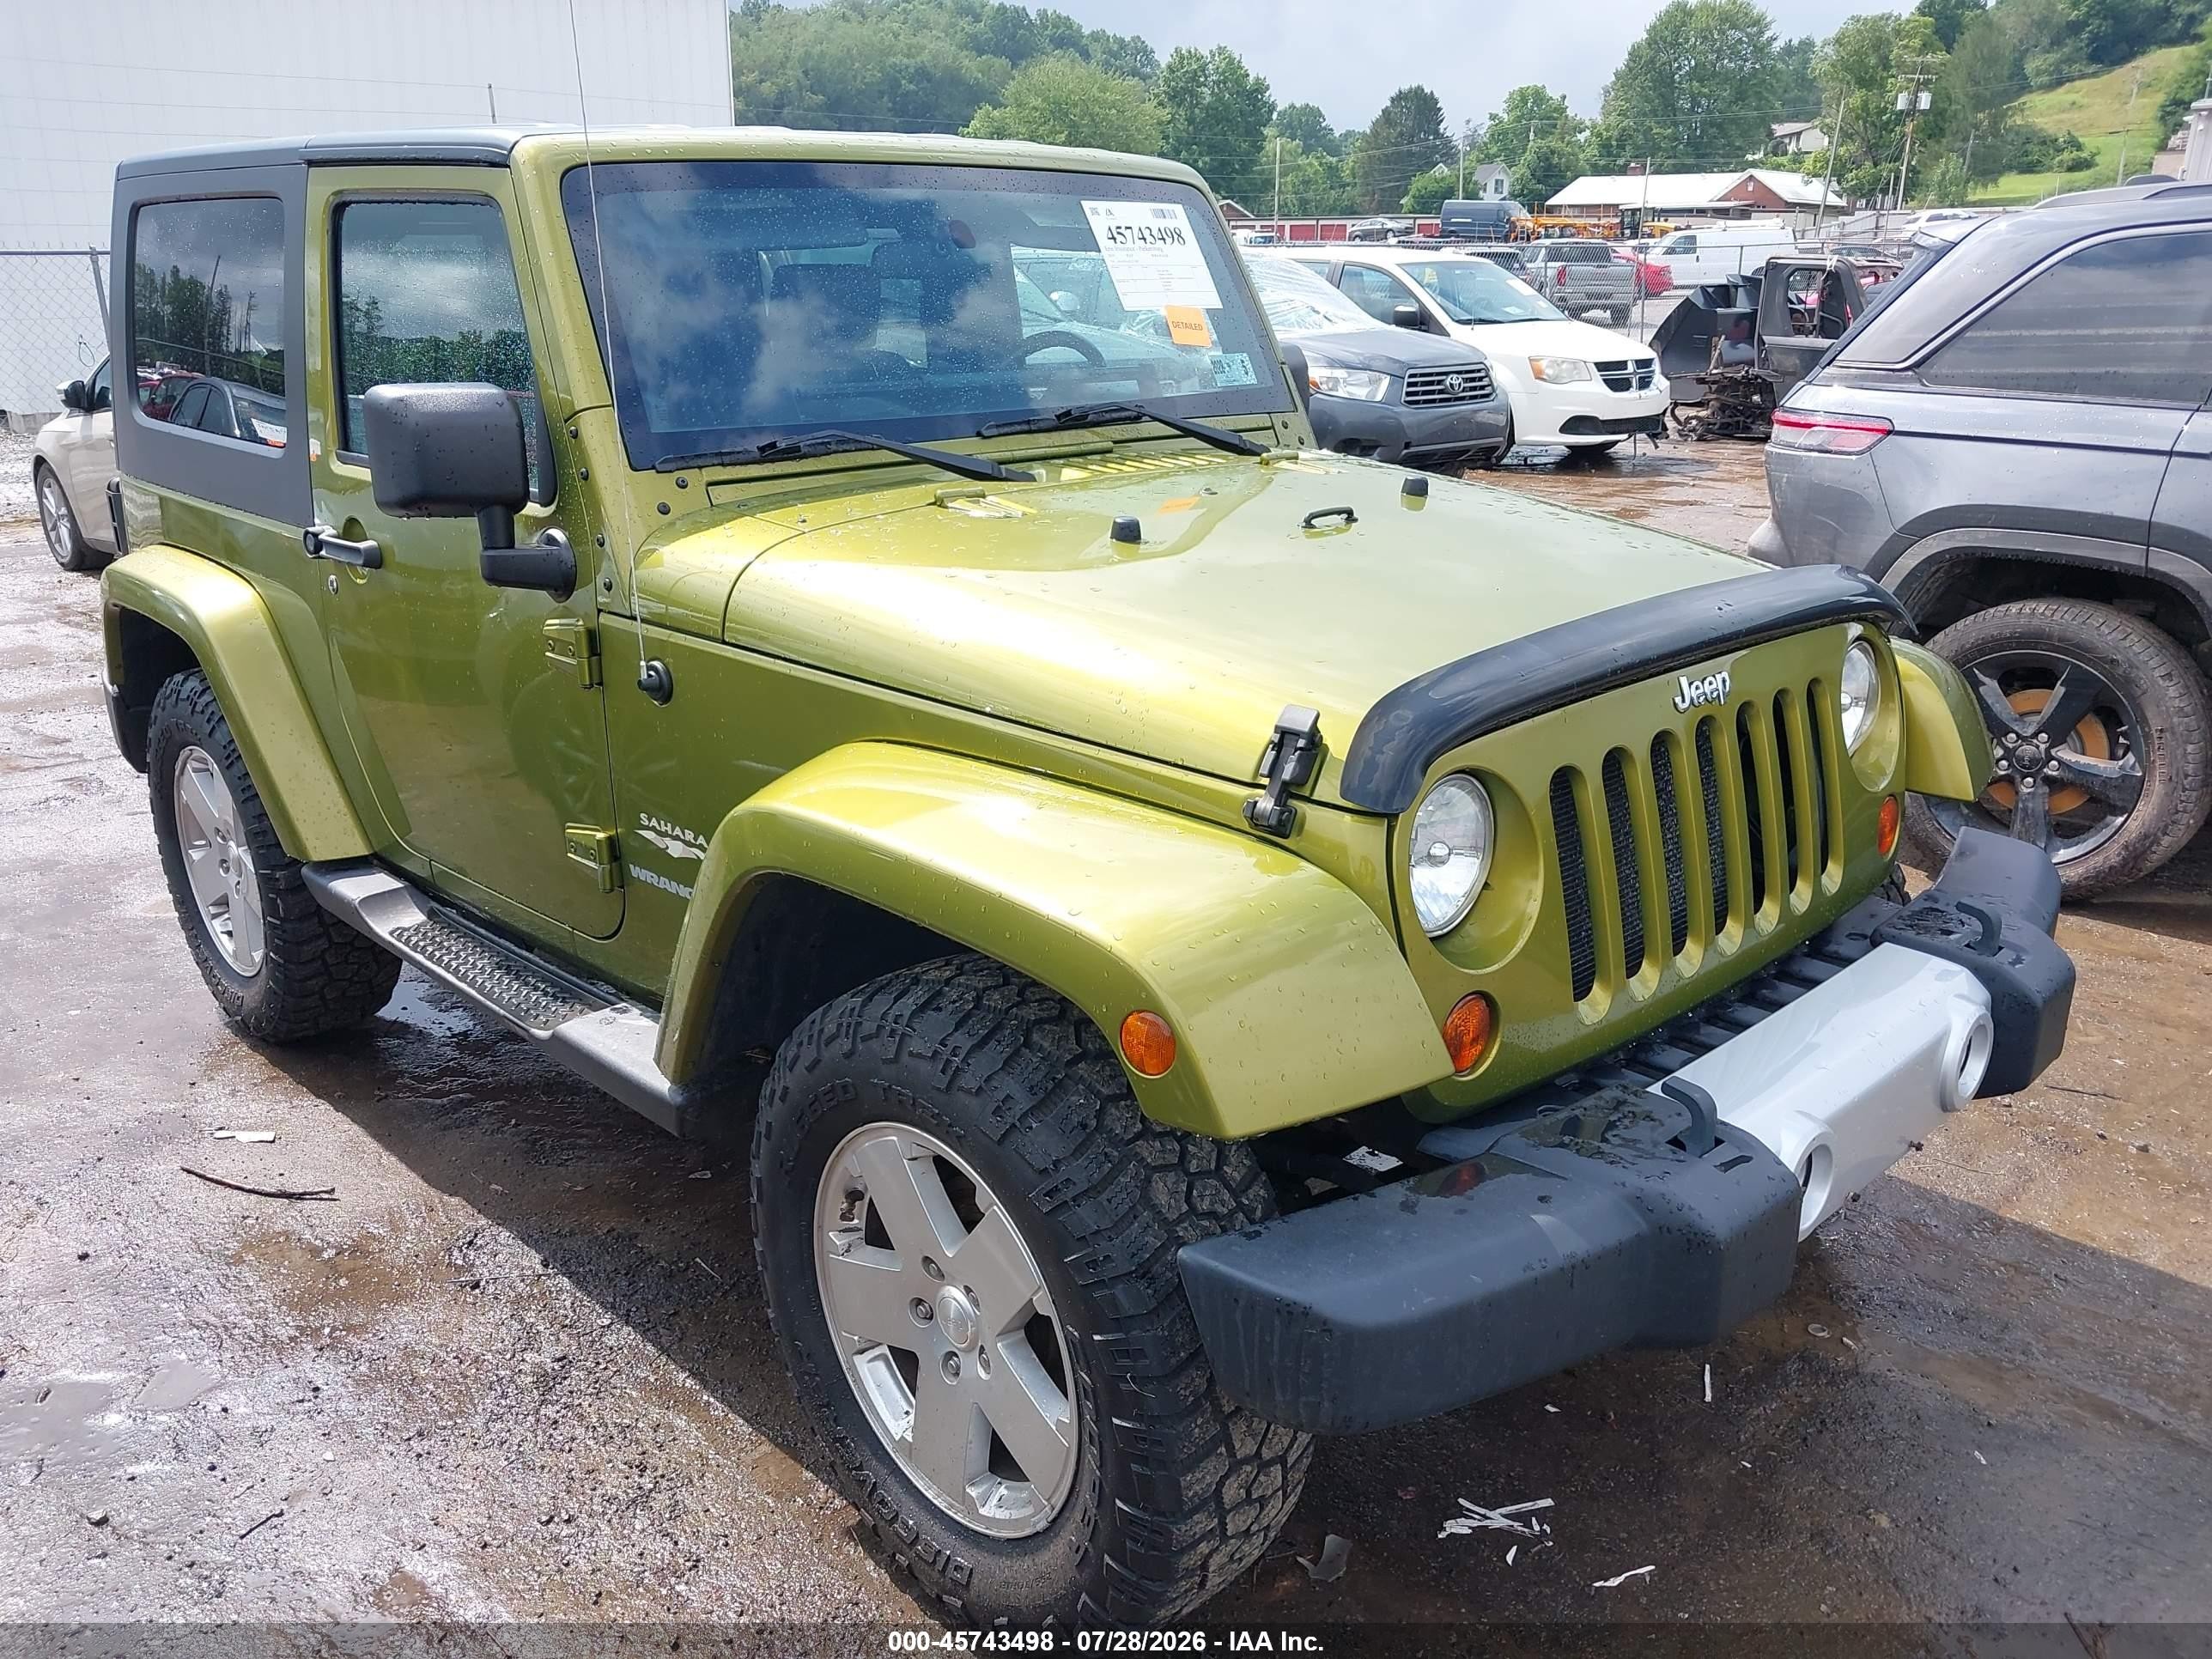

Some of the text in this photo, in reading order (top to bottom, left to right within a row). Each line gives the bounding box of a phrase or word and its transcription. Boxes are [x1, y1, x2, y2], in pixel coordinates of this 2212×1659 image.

[1107, 226, 1186, 246] 45743498
[1171, 320, 1203, 331] DETAILED
[1673, 672, 1730, 714] Jeep
[639, 812, 708, 848] SAHARA
[629, 864, 694, 900] WRANG
